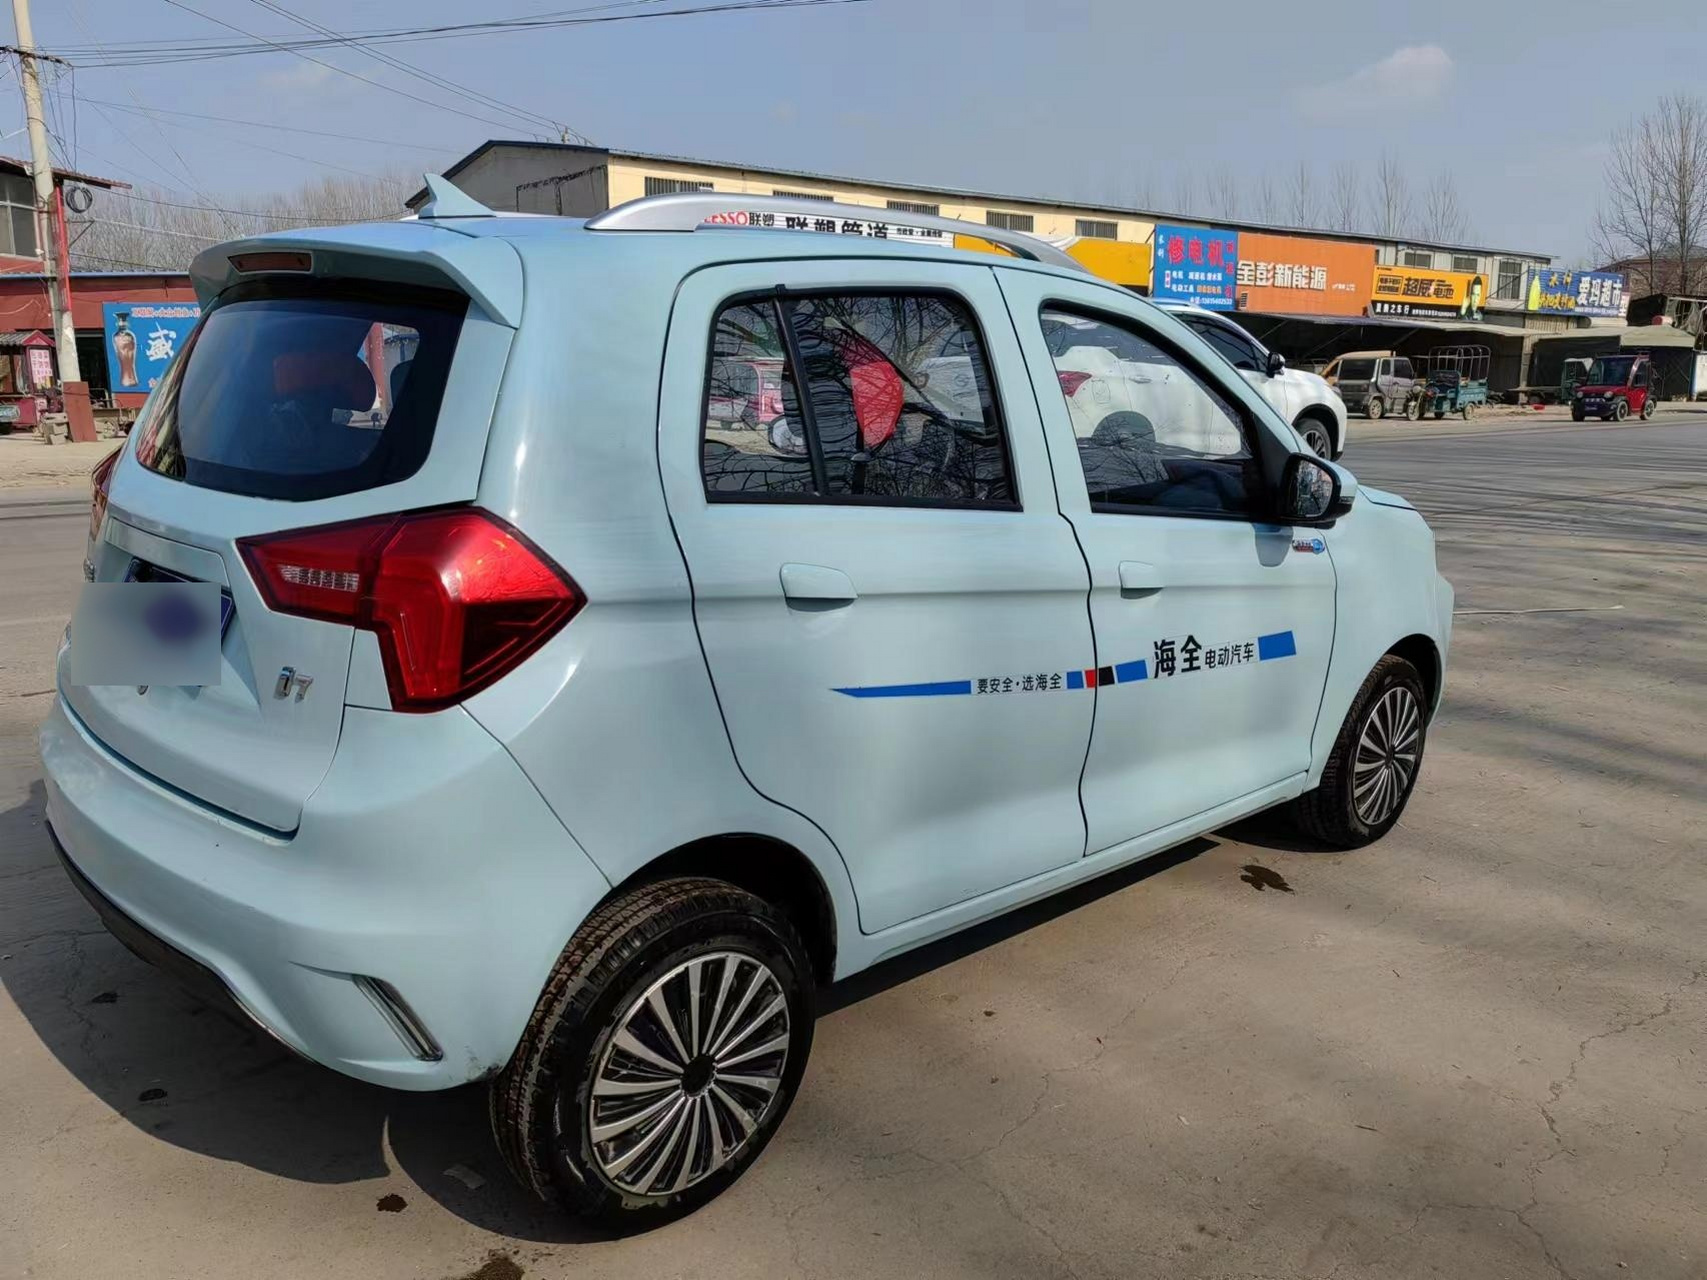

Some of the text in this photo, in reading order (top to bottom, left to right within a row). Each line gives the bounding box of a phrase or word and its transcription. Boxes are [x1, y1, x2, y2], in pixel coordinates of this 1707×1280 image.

[749, 212, 774, 226] 联塑
[1167, 235, 1224, 267] 修电机
[977, 673, 1062, 694] 要安全·选海全
